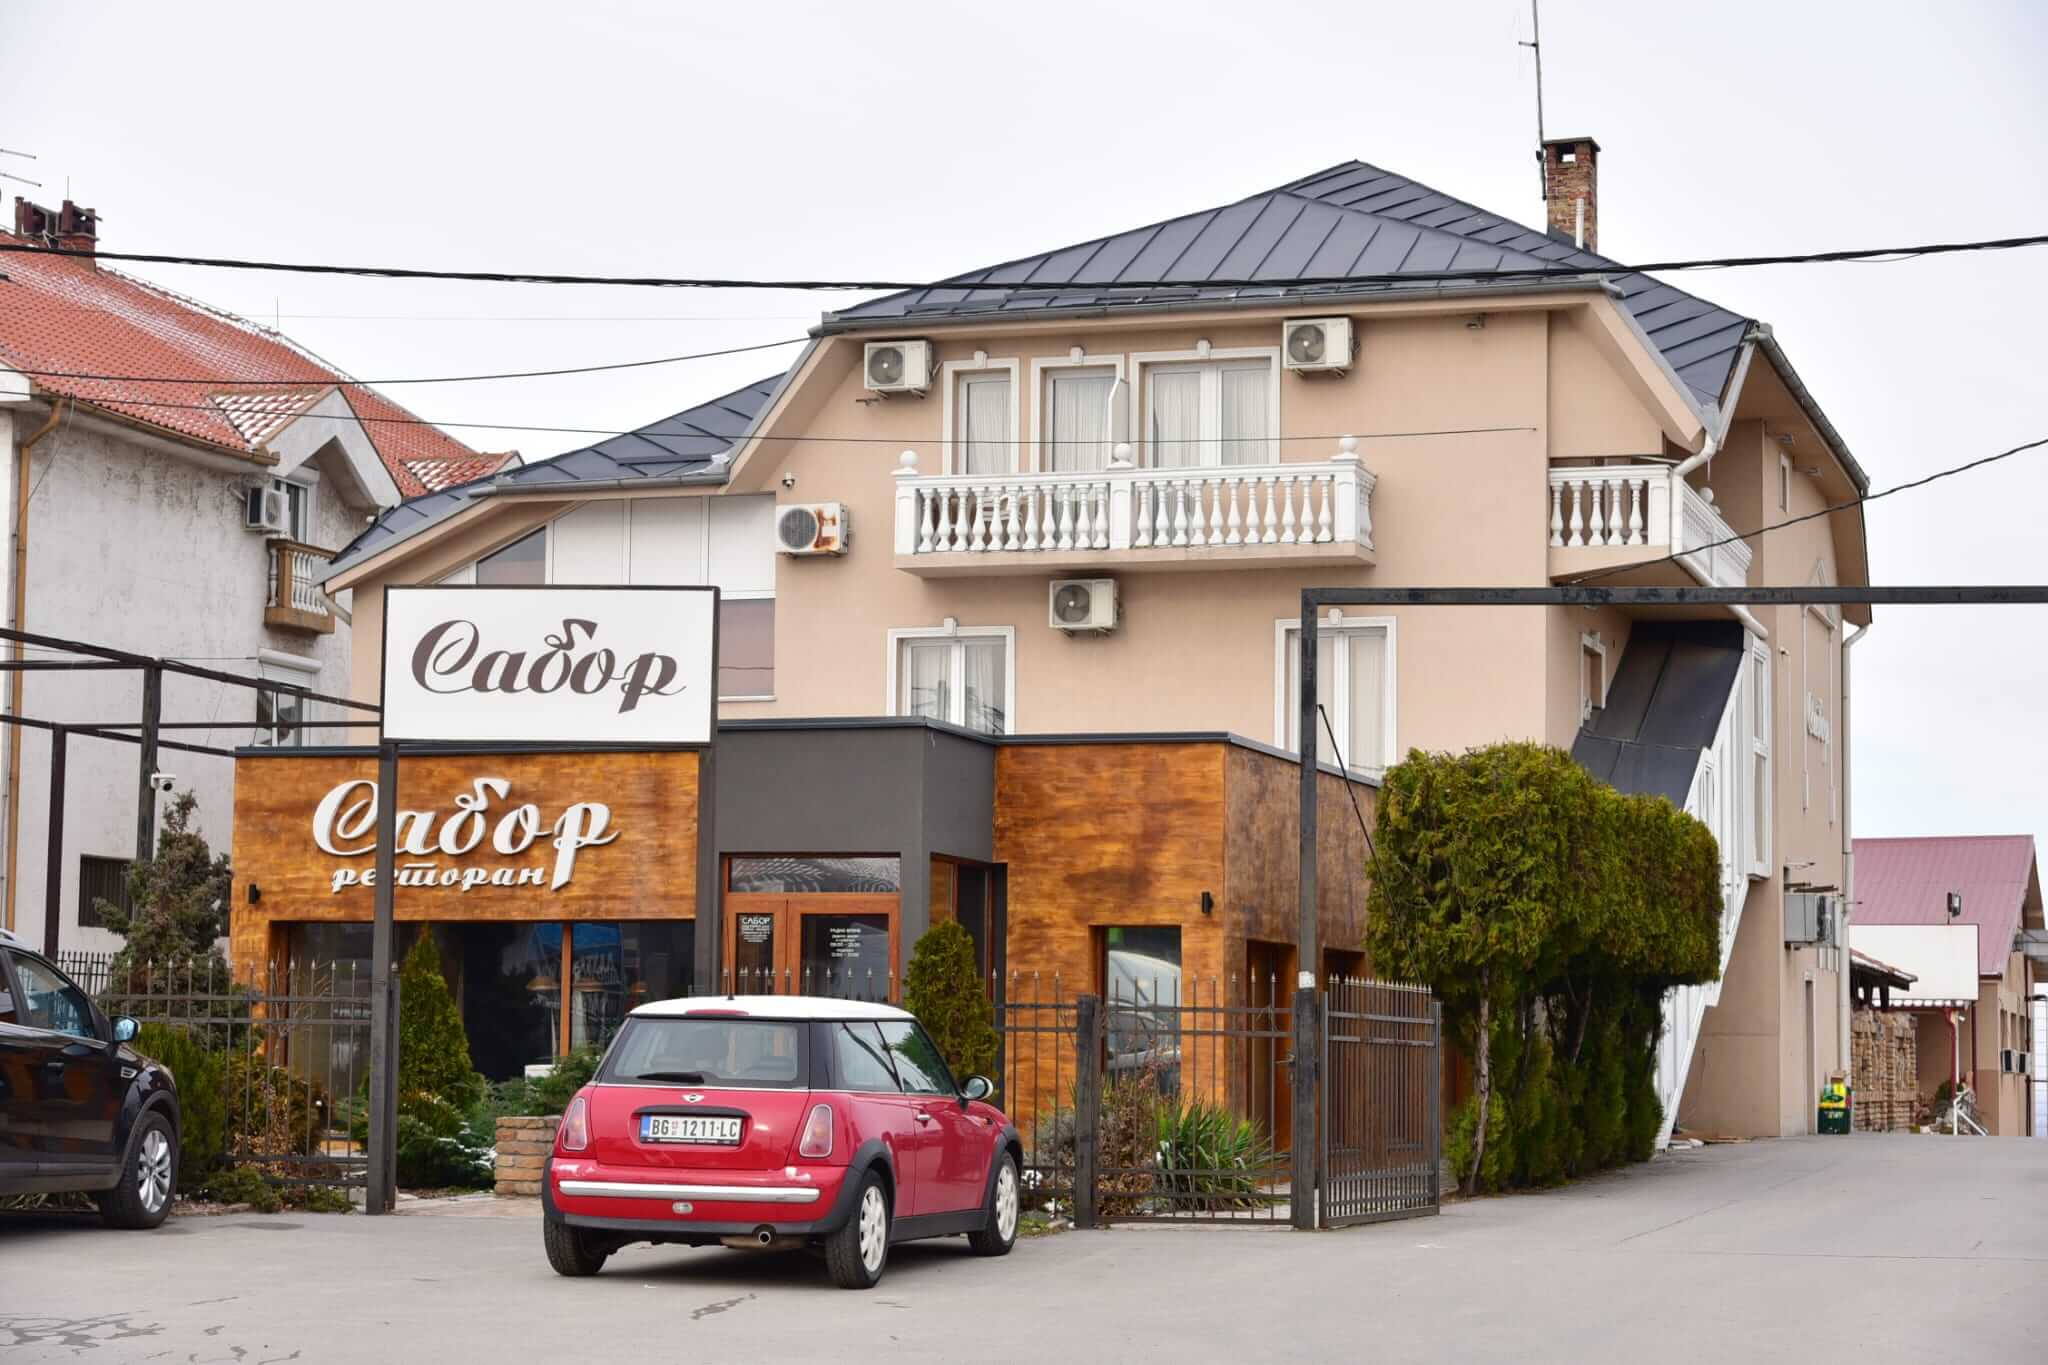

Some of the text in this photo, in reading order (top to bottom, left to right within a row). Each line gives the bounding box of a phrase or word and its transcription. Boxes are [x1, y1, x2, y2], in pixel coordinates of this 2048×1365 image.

[411, 618, 686, 714] Сабор
[312, 777, 621, 892] Сабор
[652, 1119, 669, 1136] BG
